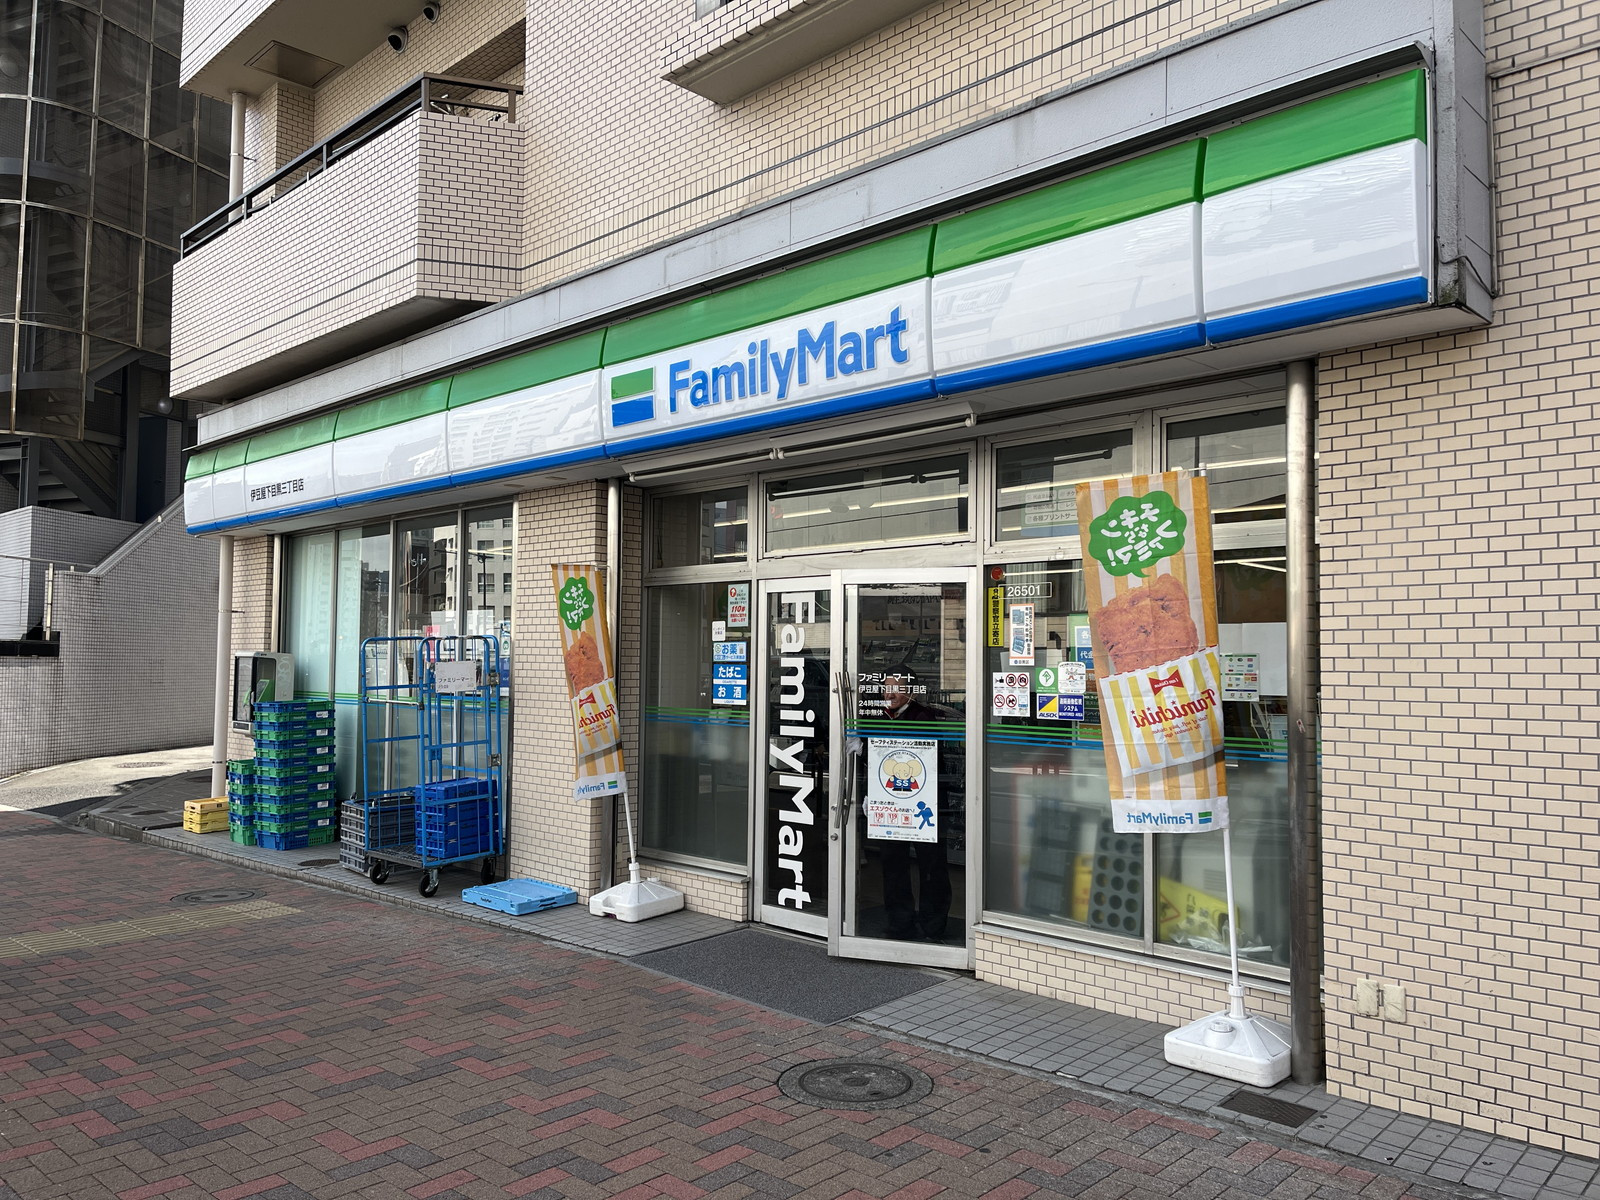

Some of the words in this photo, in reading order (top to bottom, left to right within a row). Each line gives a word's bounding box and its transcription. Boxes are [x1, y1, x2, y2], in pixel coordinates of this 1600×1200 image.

[668, 305, 909, 414] FamilyMart
[250, 478, 304, 502] 伊豆屋下目黒三丁目店
[1007, 585, 1041, 597] 26501
[721, 643, 738, 655] お薬
[718, 665, 742, 678] たばこ
[858, 673, 915, 682] ファミリーマート
[858, 685, 927, 694] 伊豆屋下目黒三丁目店
[769, 591, 817, 910] FamilyMart
